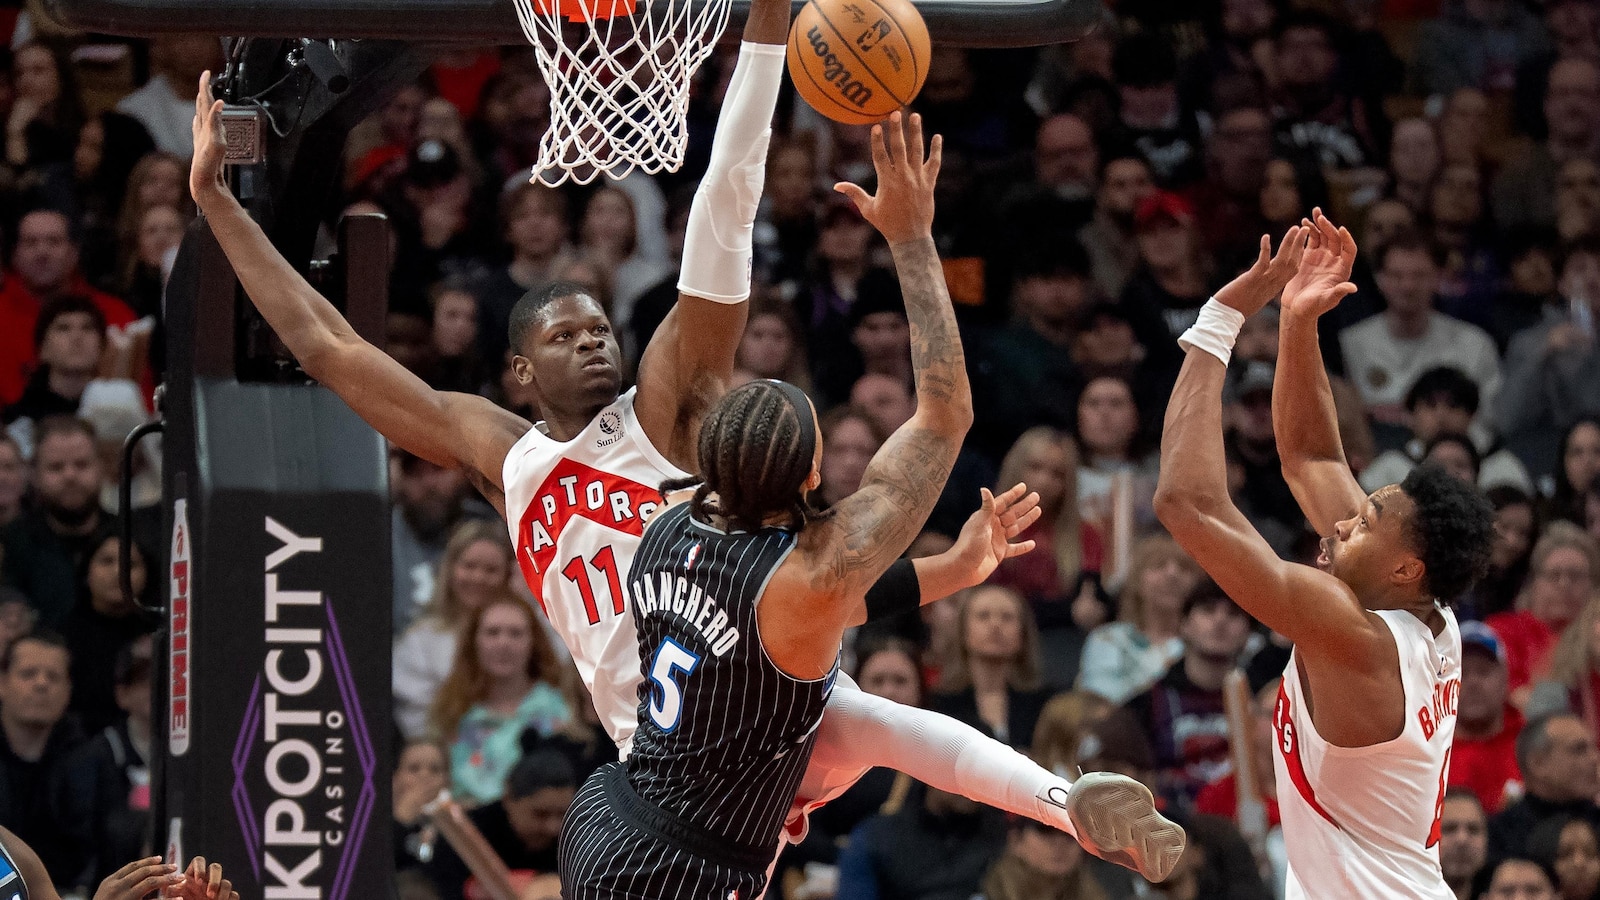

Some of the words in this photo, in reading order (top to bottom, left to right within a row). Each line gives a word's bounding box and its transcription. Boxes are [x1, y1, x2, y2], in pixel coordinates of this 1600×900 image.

[807, 25, 872, 108] Wilson
[596, 437, 614, 448] Sun
[613, 430, 625, 442] Life
[525, 475, 657, 574] APTORS
[562, 544, 626, 626] 11
[633, 571, 740, 657] BANCHERO
[172, 560, 188, 732] PRIME
[650, 634, 701, 735] 5
[325, 710, 344, 846] CASINO
